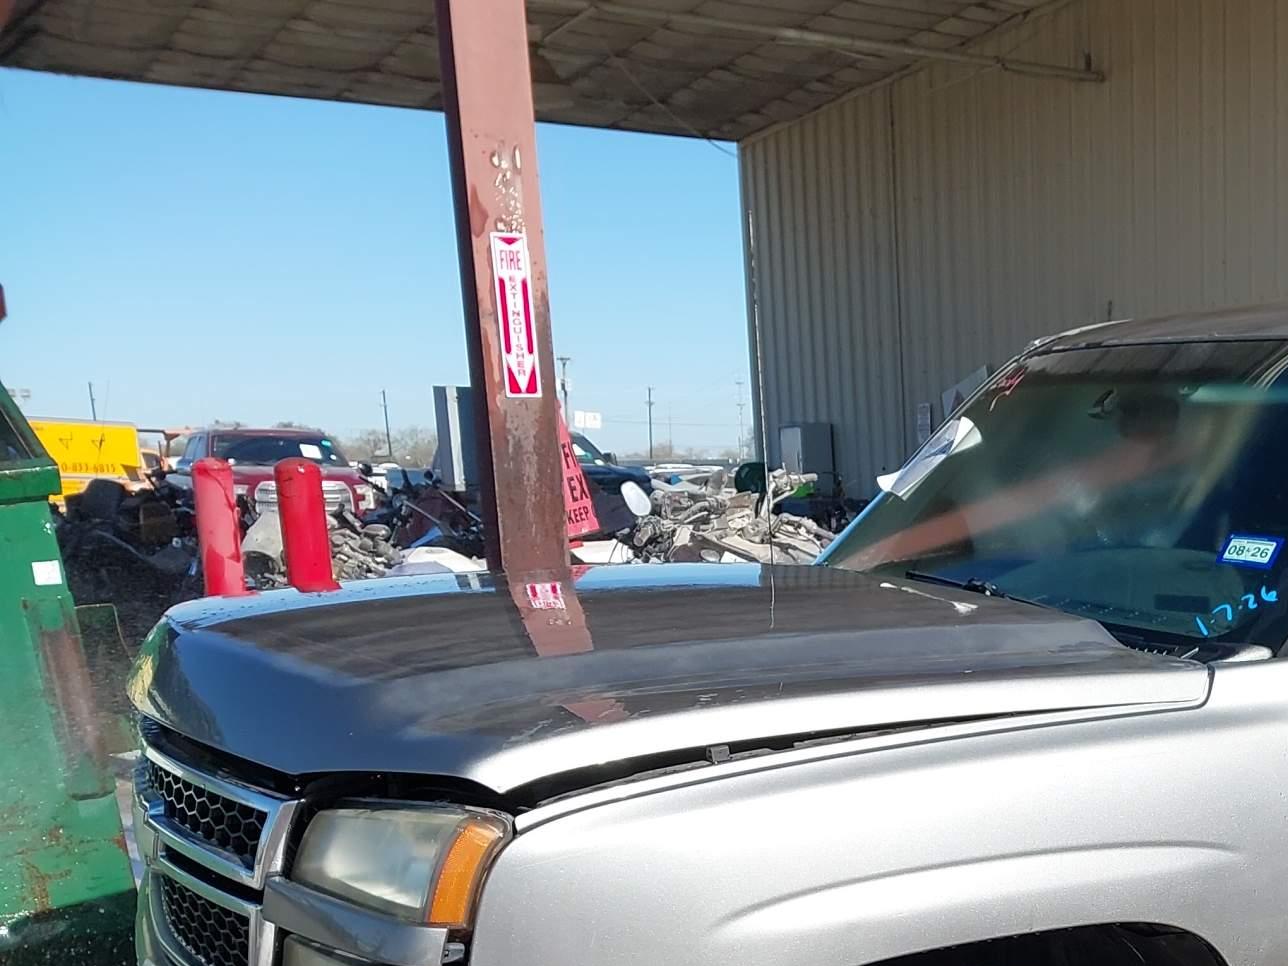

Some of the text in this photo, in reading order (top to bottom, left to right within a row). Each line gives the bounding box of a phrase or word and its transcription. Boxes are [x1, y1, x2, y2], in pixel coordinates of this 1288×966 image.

[500, 250, 522, 271] FIRE
[509, 275, 526, 376] EXTINGUISHER
[567, 475, 589, 502] EX
[567, 506, 589, 525] KEEP
